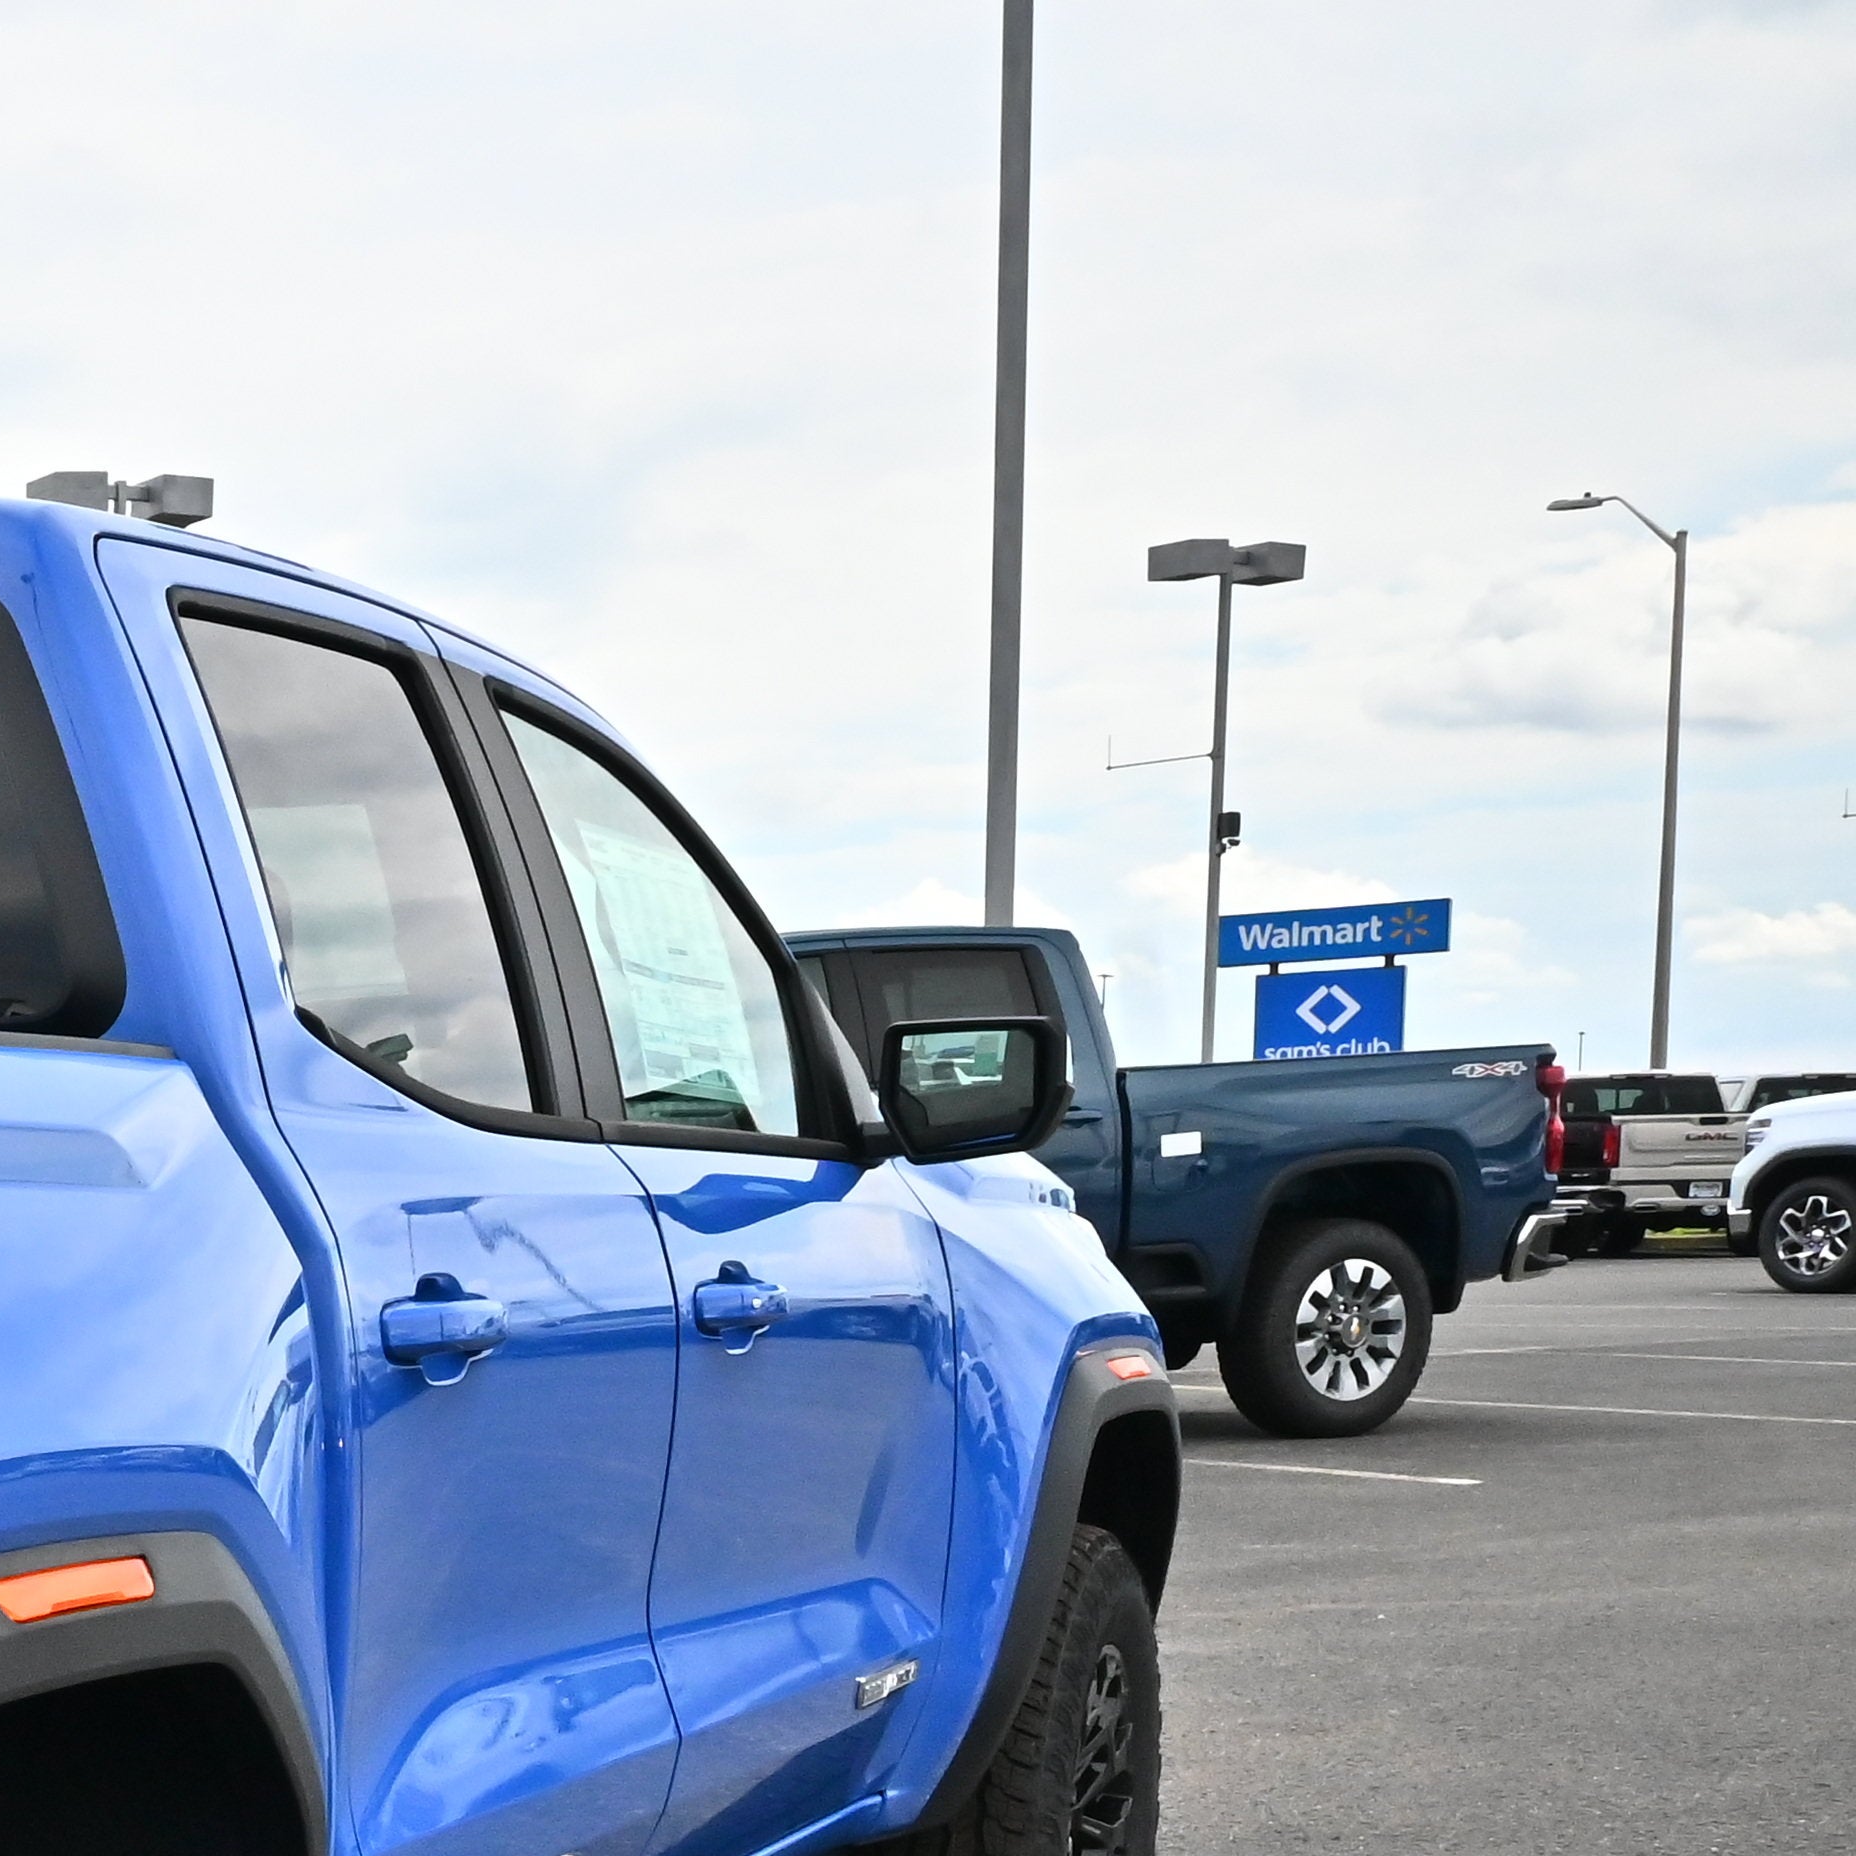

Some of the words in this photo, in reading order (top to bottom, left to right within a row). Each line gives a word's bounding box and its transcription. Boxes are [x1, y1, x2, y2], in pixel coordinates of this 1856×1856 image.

[1238, 915, 1383, 952] Walmart
[1263, 1041, 1331, 1060] sam's
[1336, 1036, 1390, 1055] club
[1685, 1131, 1739, 1141] GMC
